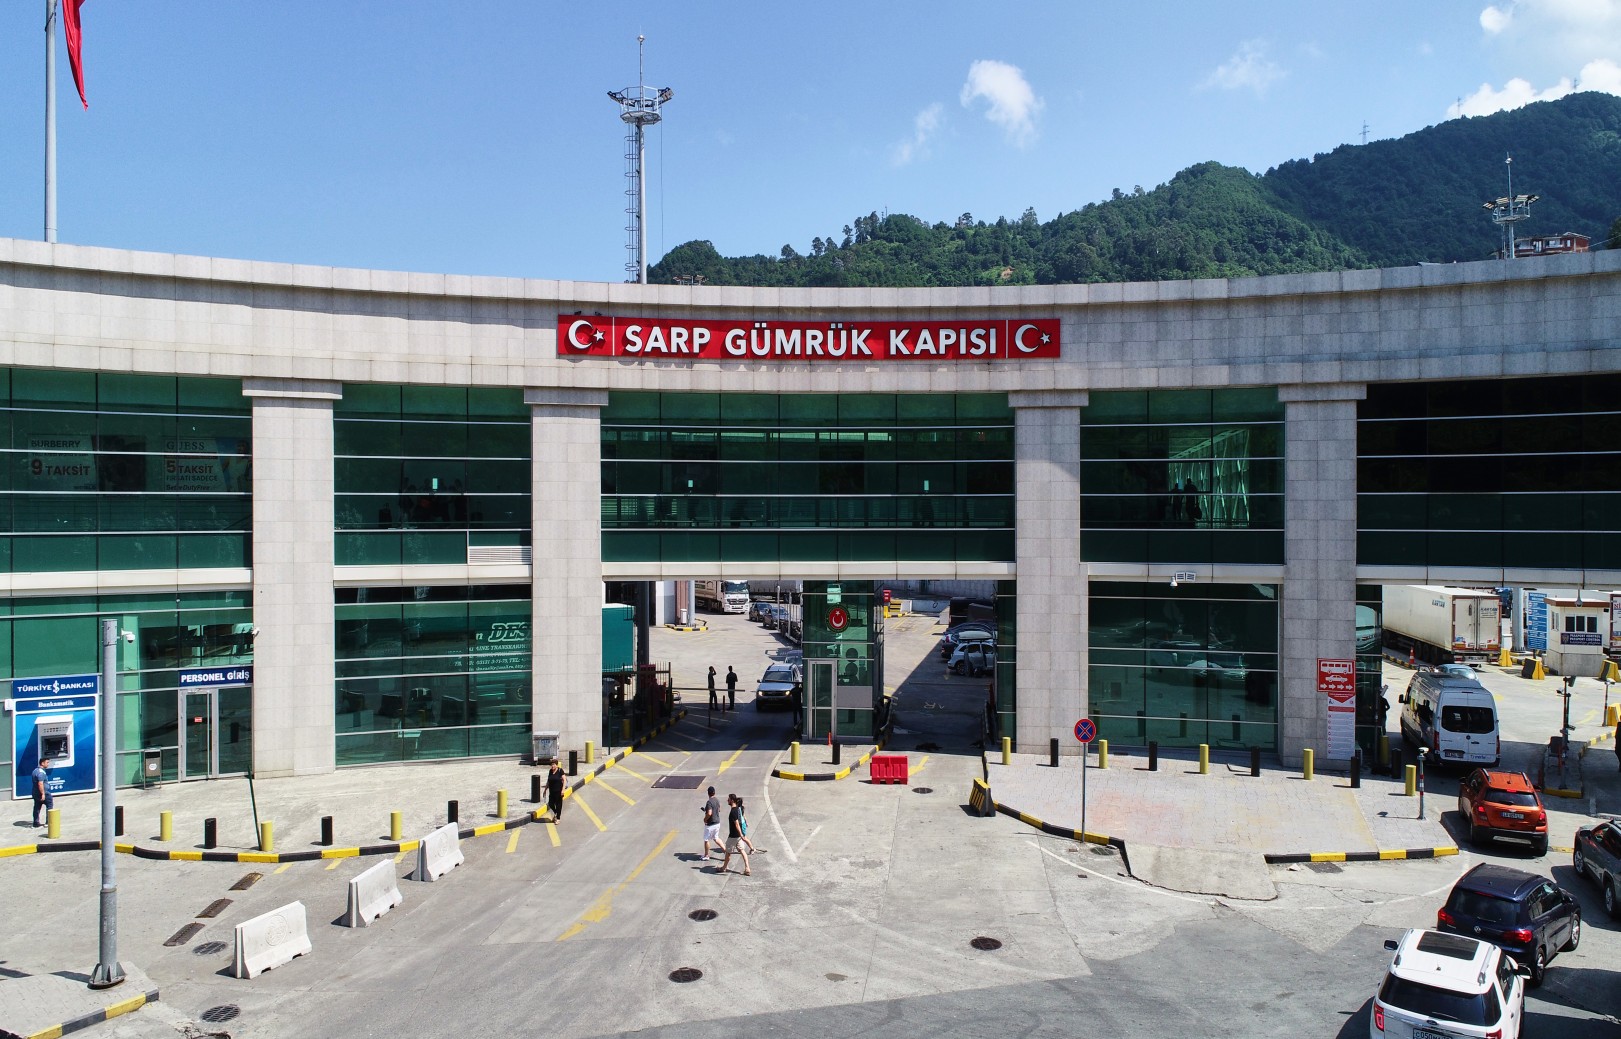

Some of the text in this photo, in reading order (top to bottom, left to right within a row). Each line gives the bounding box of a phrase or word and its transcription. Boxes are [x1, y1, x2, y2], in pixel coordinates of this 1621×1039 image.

[625, 322, 997, 356] SARP GÜMRÜK KAPISI
[31, 440, 81, 448] BURBERRY
[31, 458, 91, 476] 9 TAKSİT
[166, 460, 213, 474] 5 TAKSİT
[180, 669, 250, 683] PERSONEL GİRİŞ
[17, 681, 94, 692] TÜRKİYE BANKASI
[38, 700, 74, 708] Bankamatik
